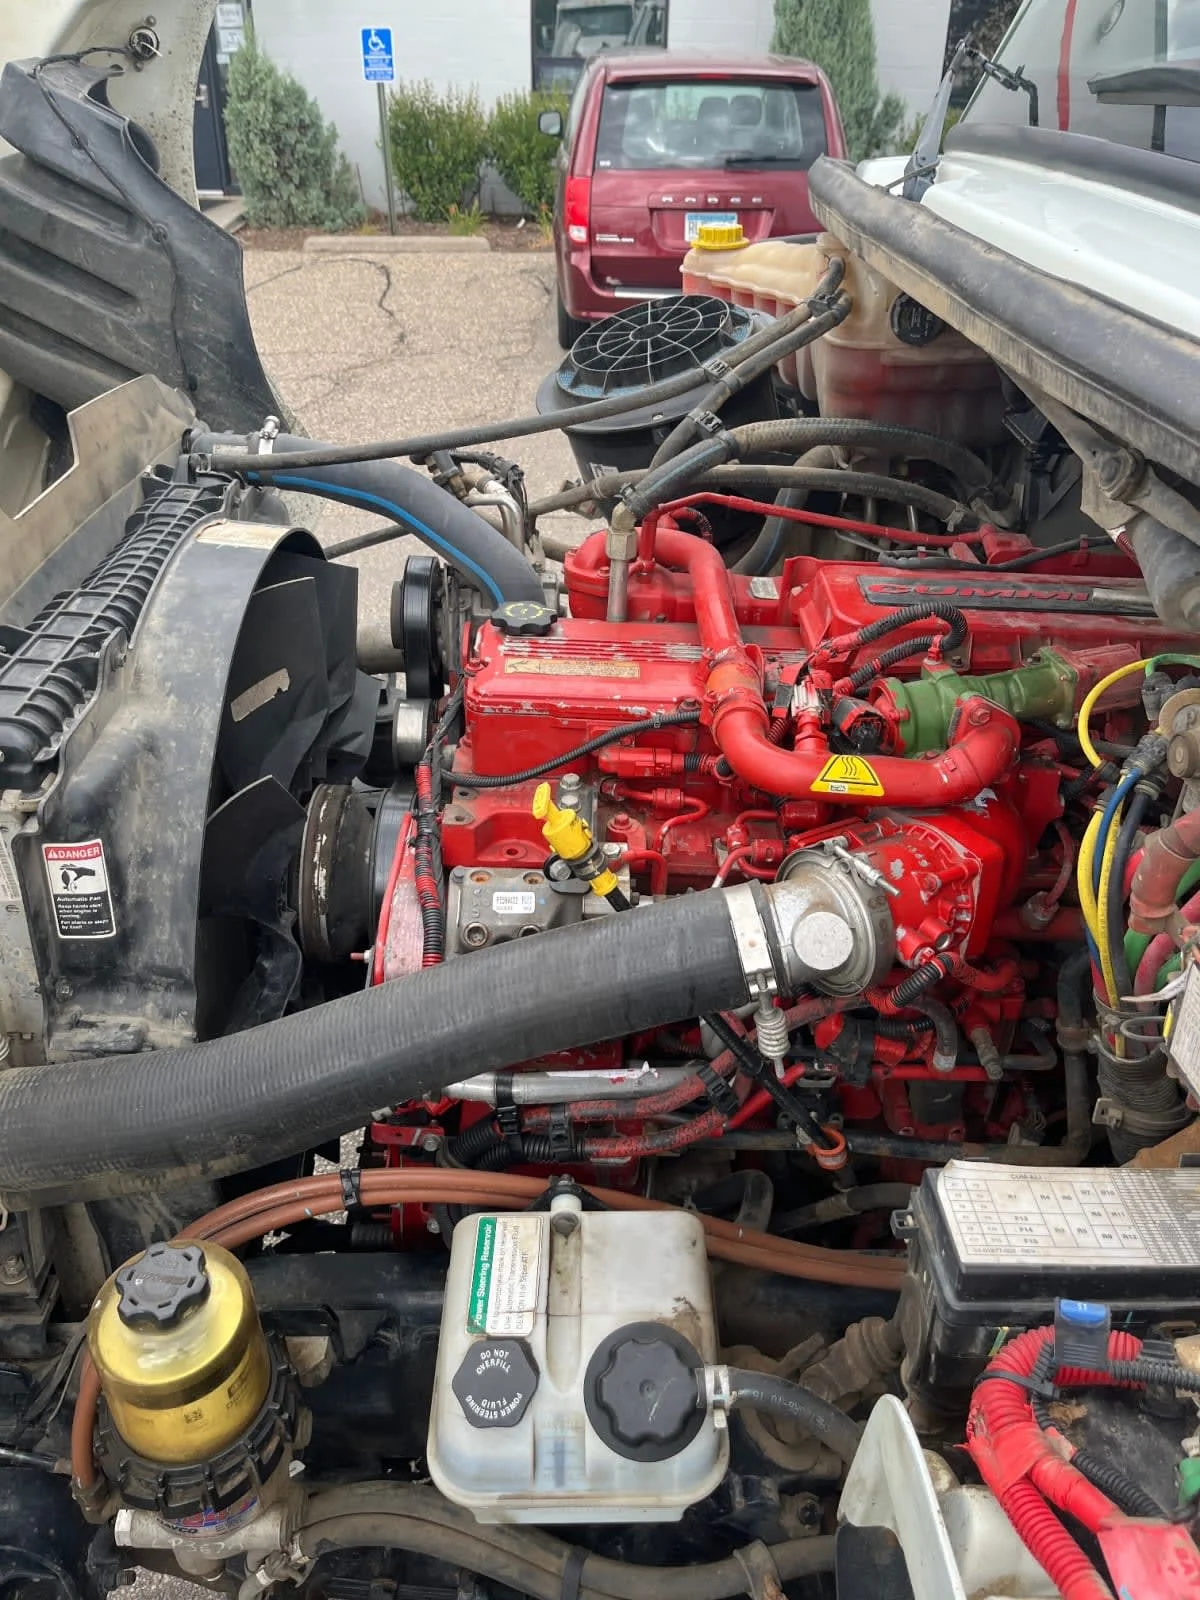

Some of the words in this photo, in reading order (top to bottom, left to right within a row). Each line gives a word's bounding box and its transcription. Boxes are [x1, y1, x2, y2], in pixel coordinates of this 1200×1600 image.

[867, 584, 1090, 601] CUMMI
[58, 846, 100, 859] DANGER
[480, 1223, 492, 1261] Reservoir
[477, 1263, 490, 1297] Steering
[474, 1299, 484, 1326] Power
[480, 1350, 491, 1360] DO
[493, 1348, 510, 1360] NOT
[475, 1358, 512, 1375] OVERFILL
[465, 1394, 499, 1419] STEERING
[481, 1397, 508, 1409] FLUID
[500, 1392, 523, 1417] POWER
